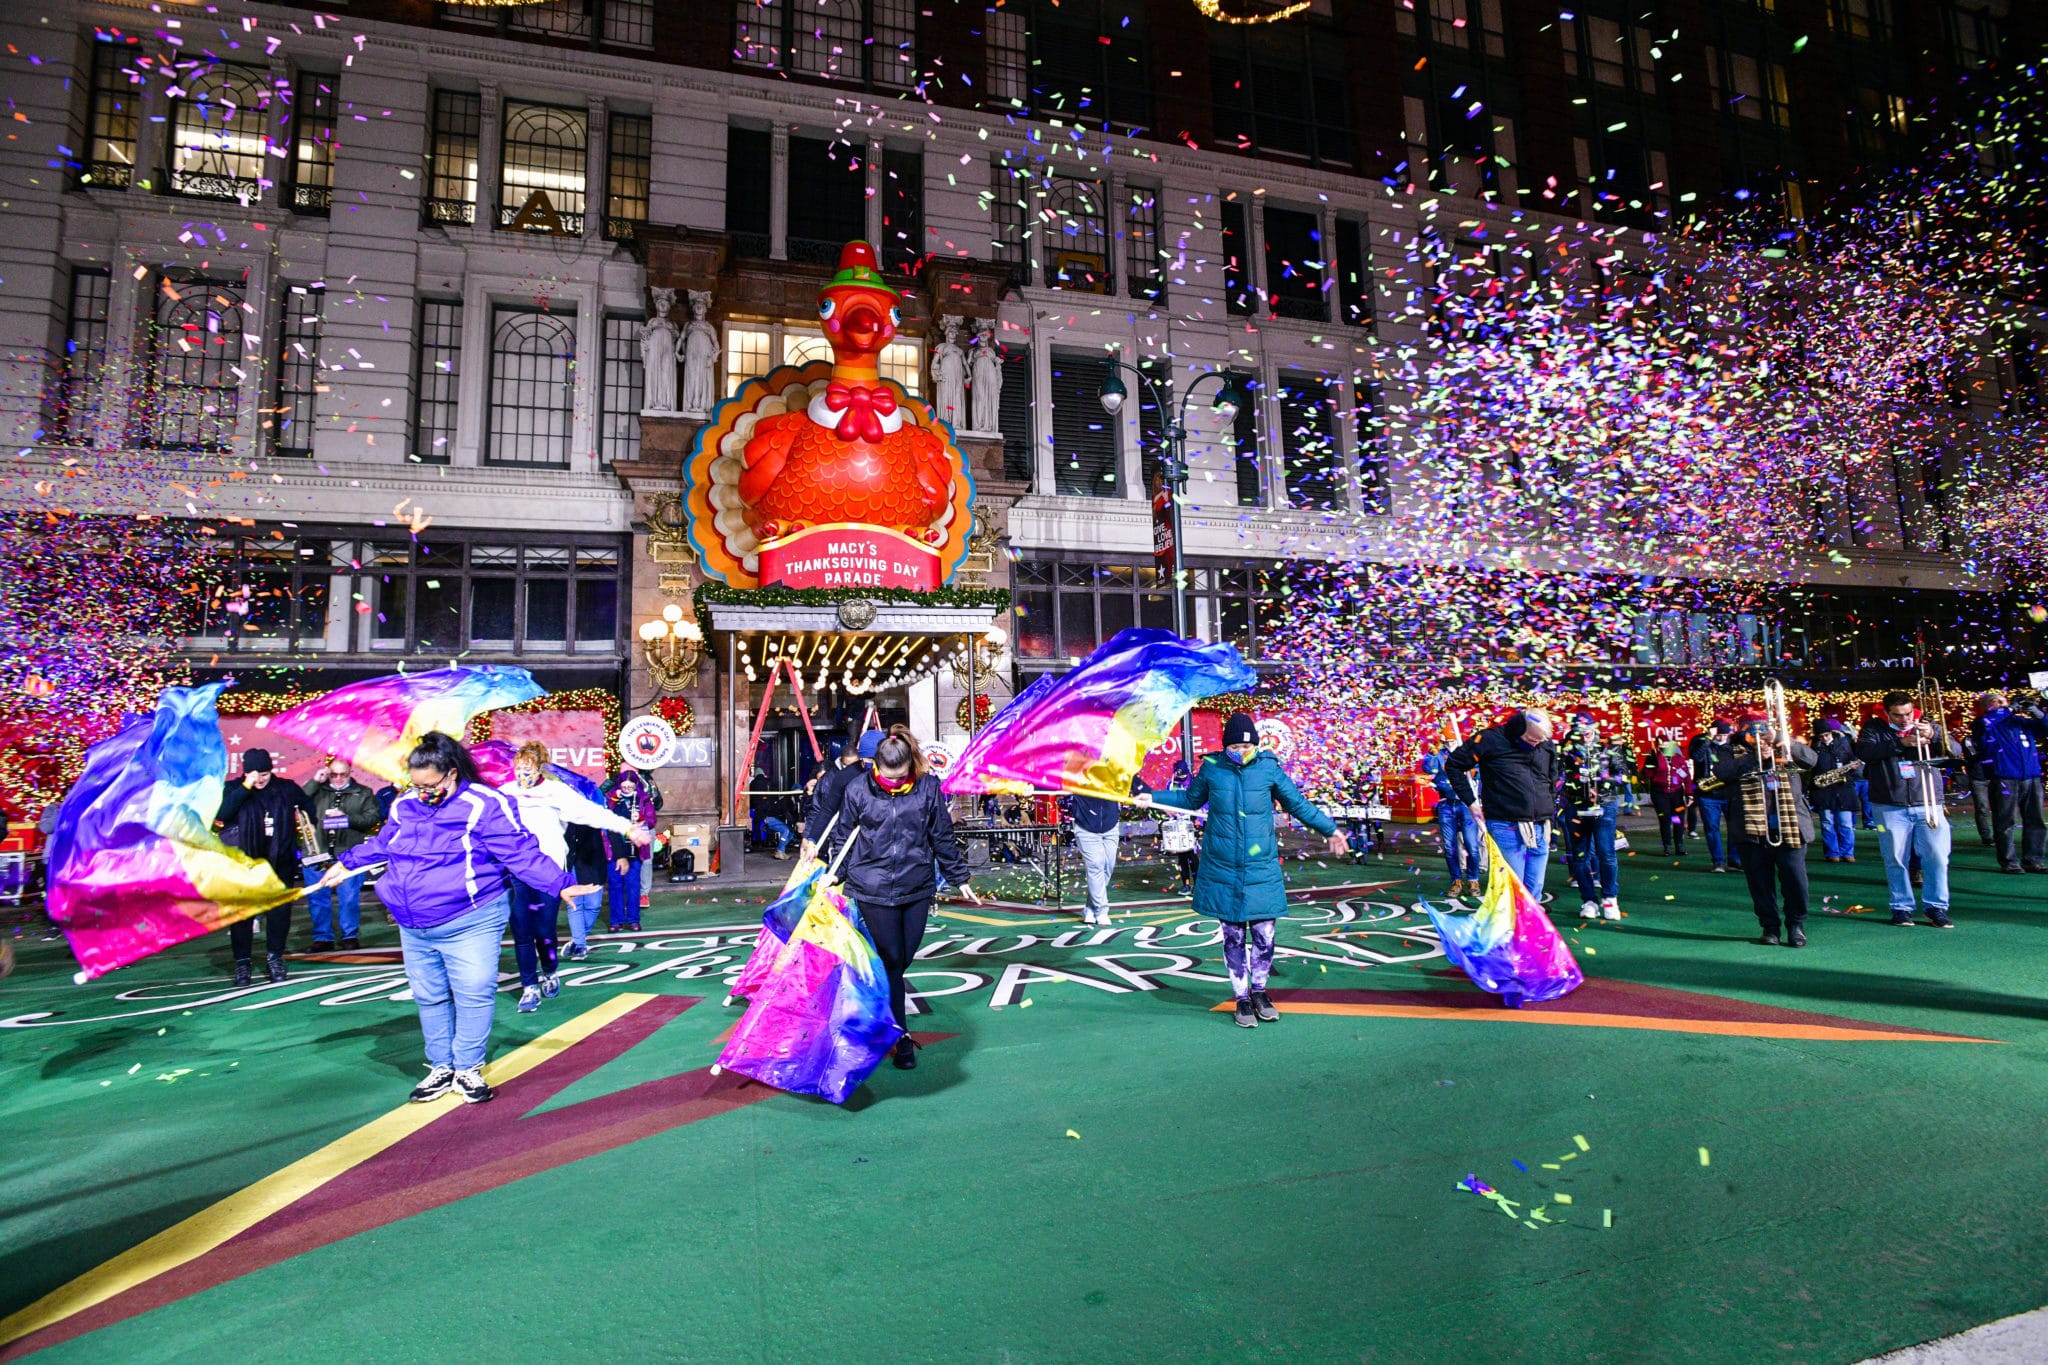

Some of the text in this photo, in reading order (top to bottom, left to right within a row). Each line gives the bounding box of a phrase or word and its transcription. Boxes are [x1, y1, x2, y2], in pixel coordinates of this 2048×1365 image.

[785, 558, 919, 578] THANKSGIVING DAY
[824, 572, 881, 585] PARADE
[627, 728, 637, 737] THE
[637, 721, 660, 729] LESBIAN
[625, 743, 669, 763] BIG APPLE CORPS
